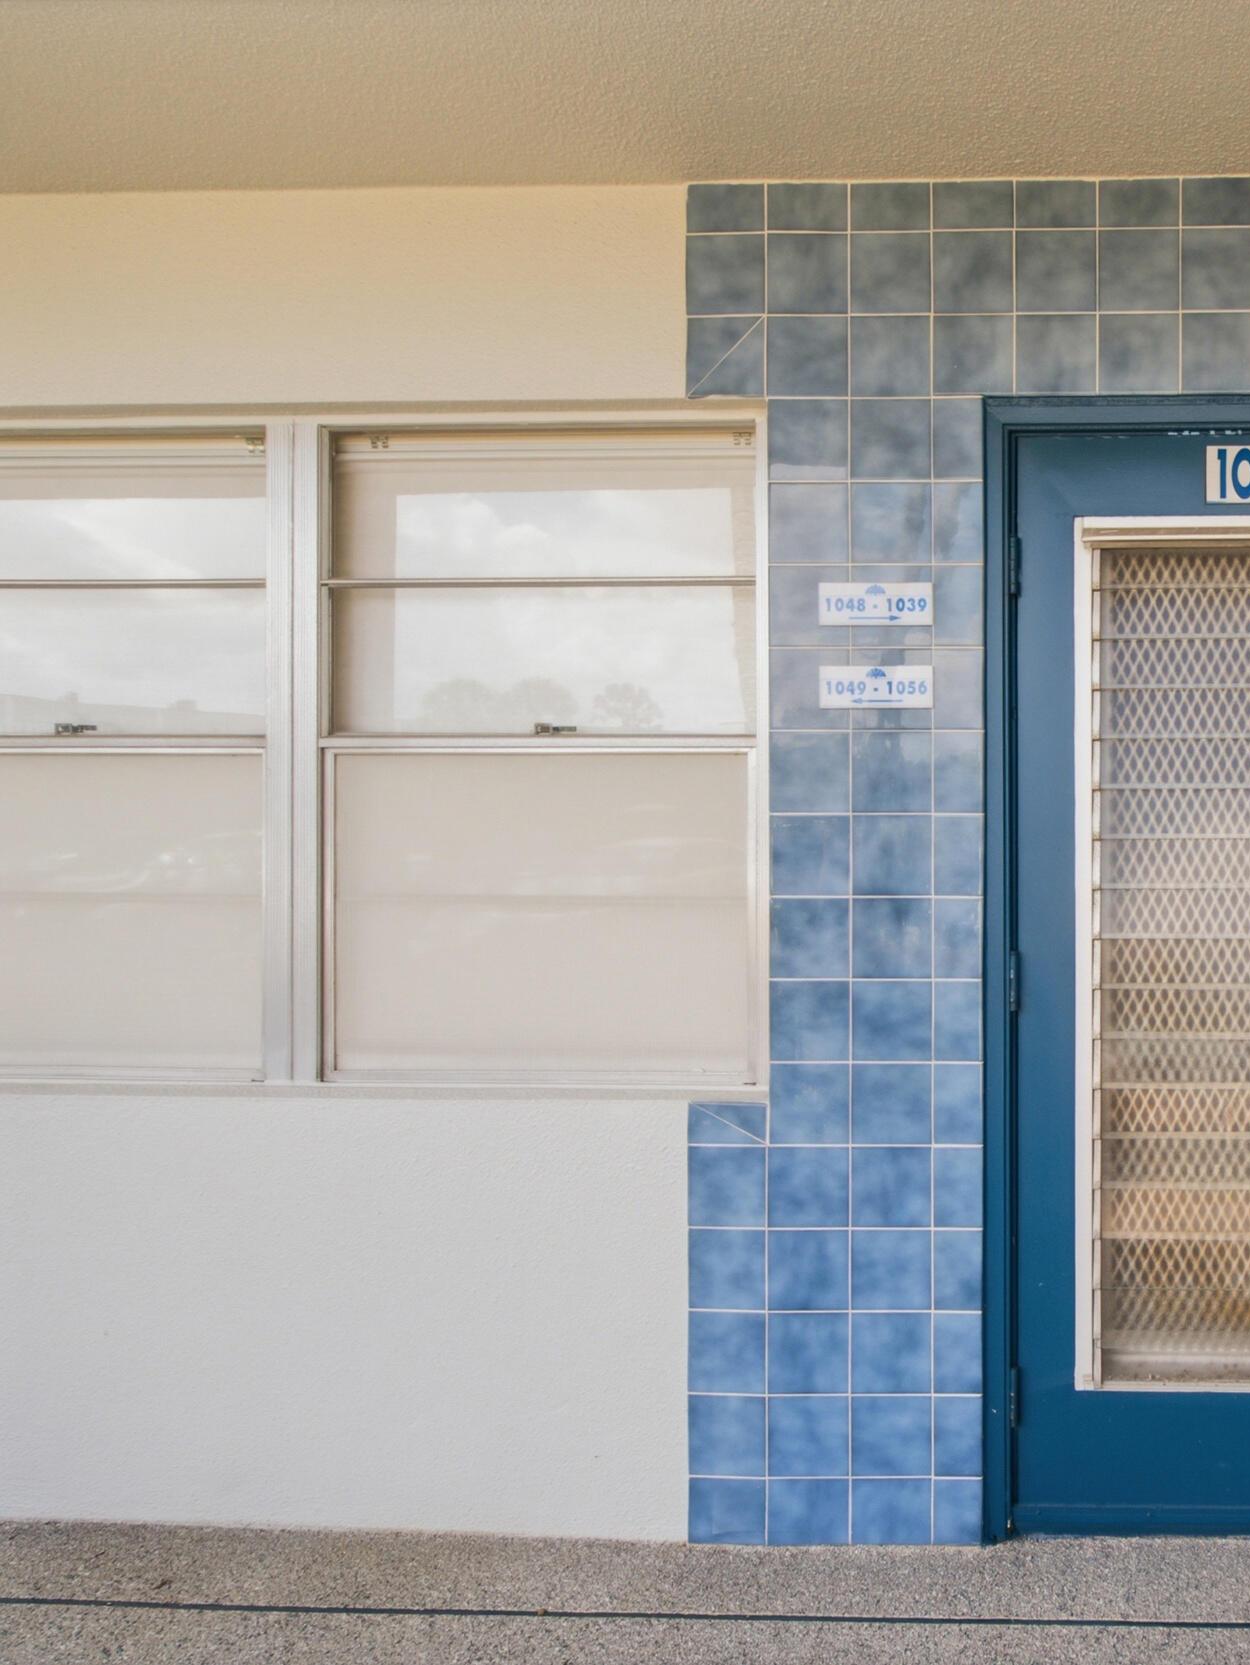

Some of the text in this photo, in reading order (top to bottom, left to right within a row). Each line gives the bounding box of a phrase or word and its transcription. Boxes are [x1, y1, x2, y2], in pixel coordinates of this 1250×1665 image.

[825, 597, 866, 612] 1048
[886, 597, 928, 612] 1039
[825, 681, 867, 695] 1049
[886, 681, 928, 695] 1056
